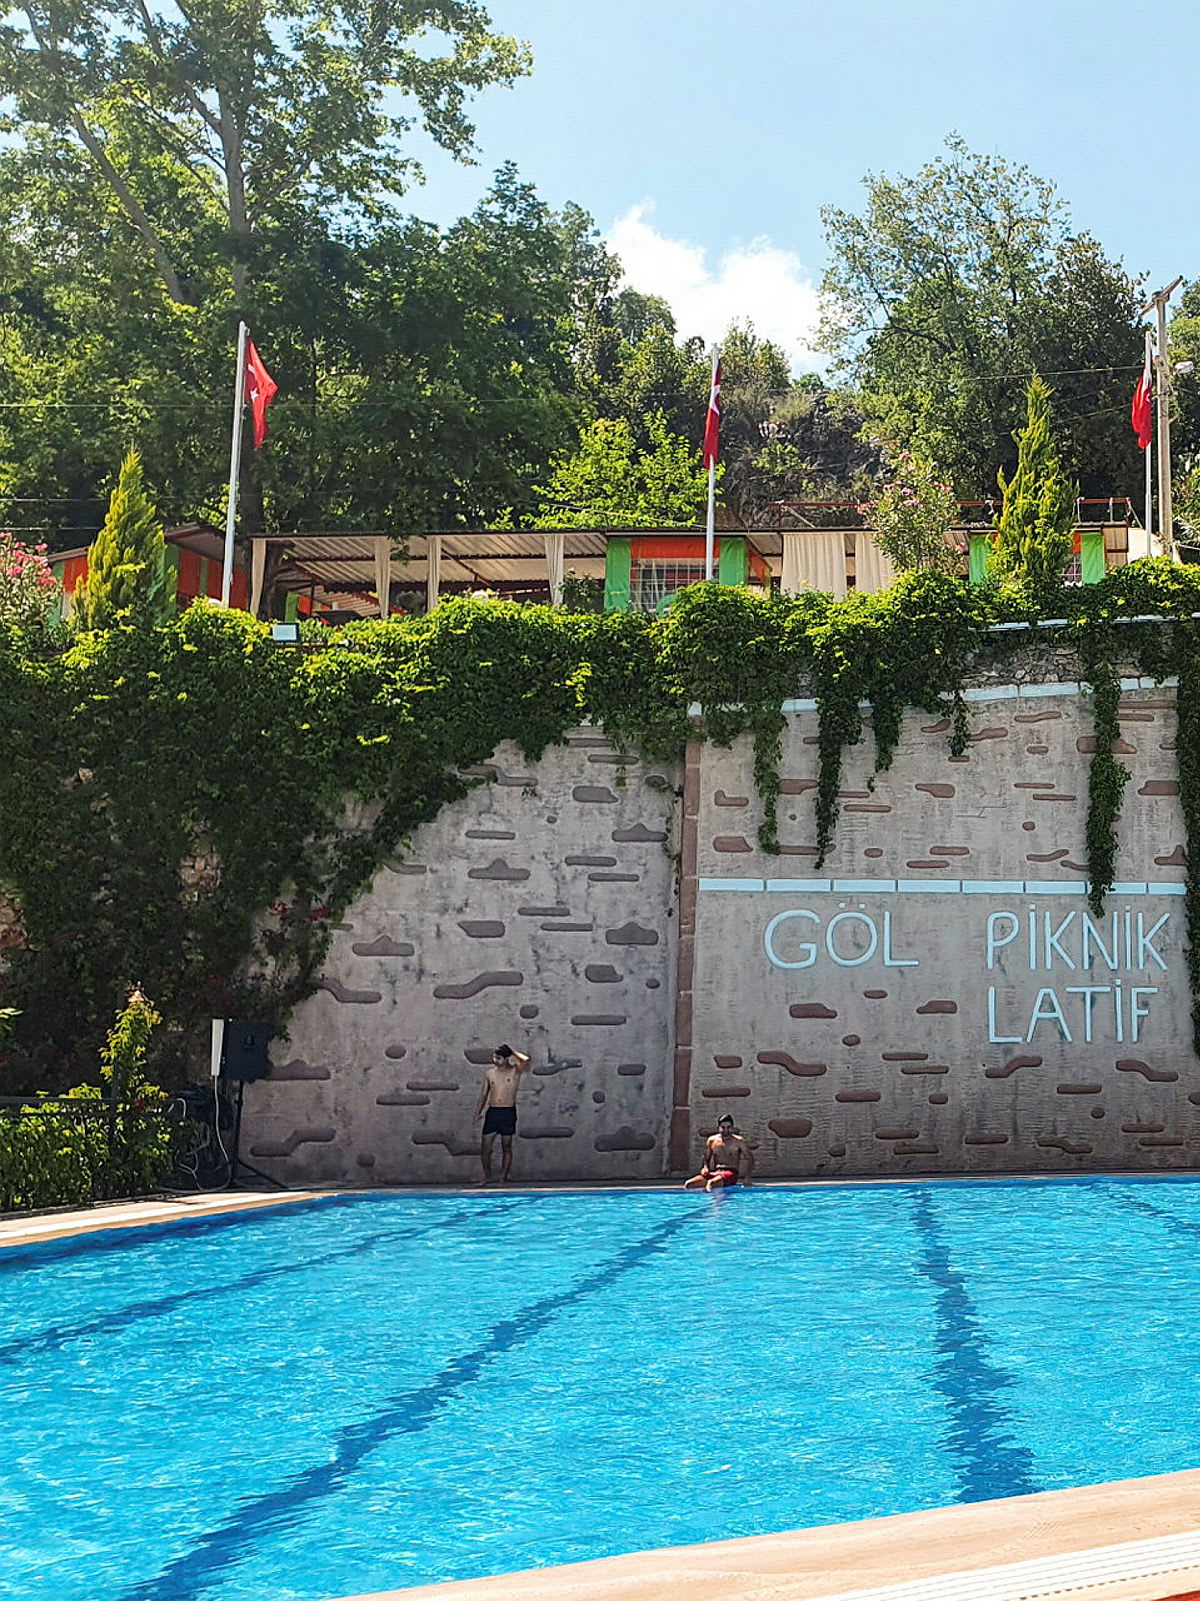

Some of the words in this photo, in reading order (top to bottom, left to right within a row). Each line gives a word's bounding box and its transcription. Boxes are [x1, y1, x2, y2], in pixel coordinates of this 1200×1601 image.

[763, 903, 919, 969] GÖL
[986, 904, 1171, 970] PİKNİK
[986, 979, 1159, 1044] LATİF
